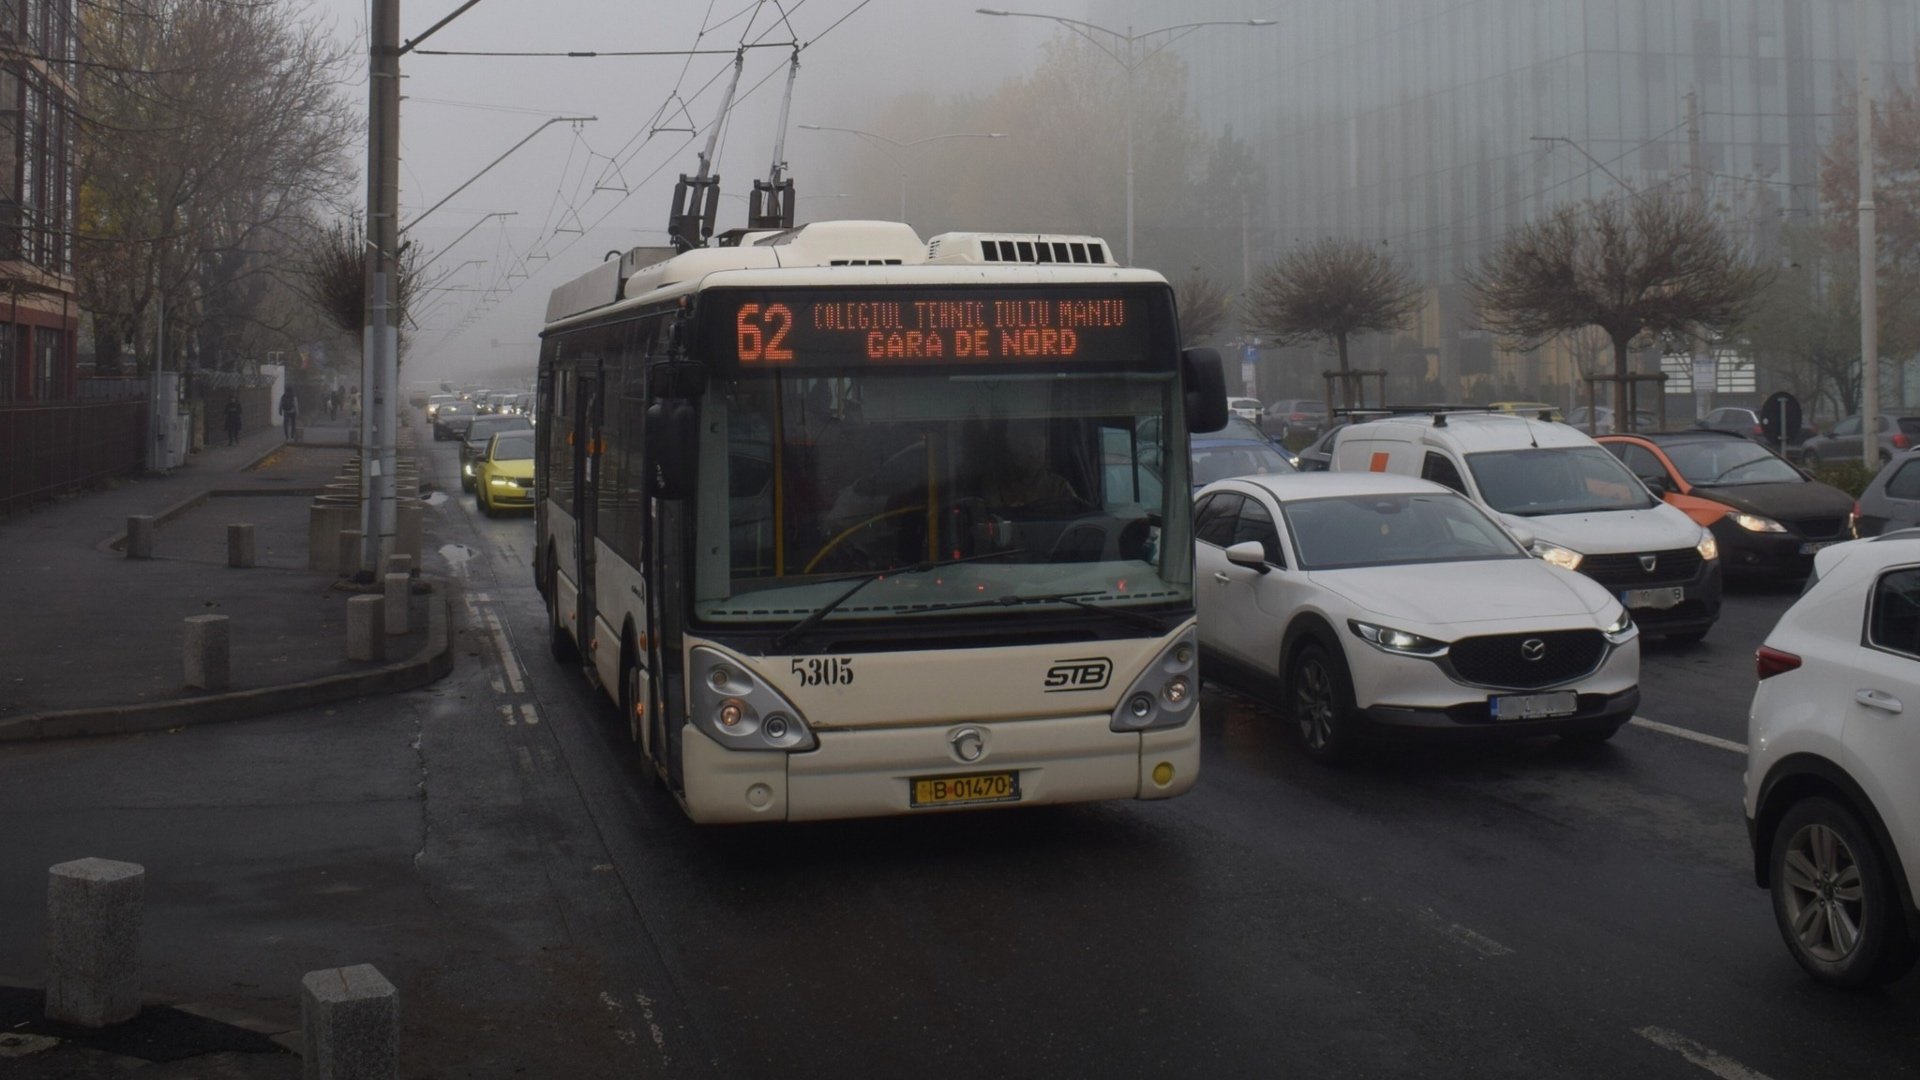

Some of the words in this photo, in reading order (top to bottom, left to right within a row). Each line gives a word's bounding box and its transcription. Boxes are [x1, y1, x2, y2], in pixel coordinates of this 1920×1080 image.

[813, 302, 904, 330] COLEGIUL
[913, 301, 985, 328] TEHNIC
[994, 300, 1049, 328] IULIU
[1059, 299, 1125, 327] MANIU
[737, 303, 793, 360] 62
[867, 330, 943, 358] GARA
[955, 329, 989, 357] DE
[1002, 328, 1077, 356] NORD
[791, 657, 854, 687] 5305
[1044, 663, 1106, 687] STB
[933, 781, 947, 800] B
[954, 776, 1007, 798] 01470
